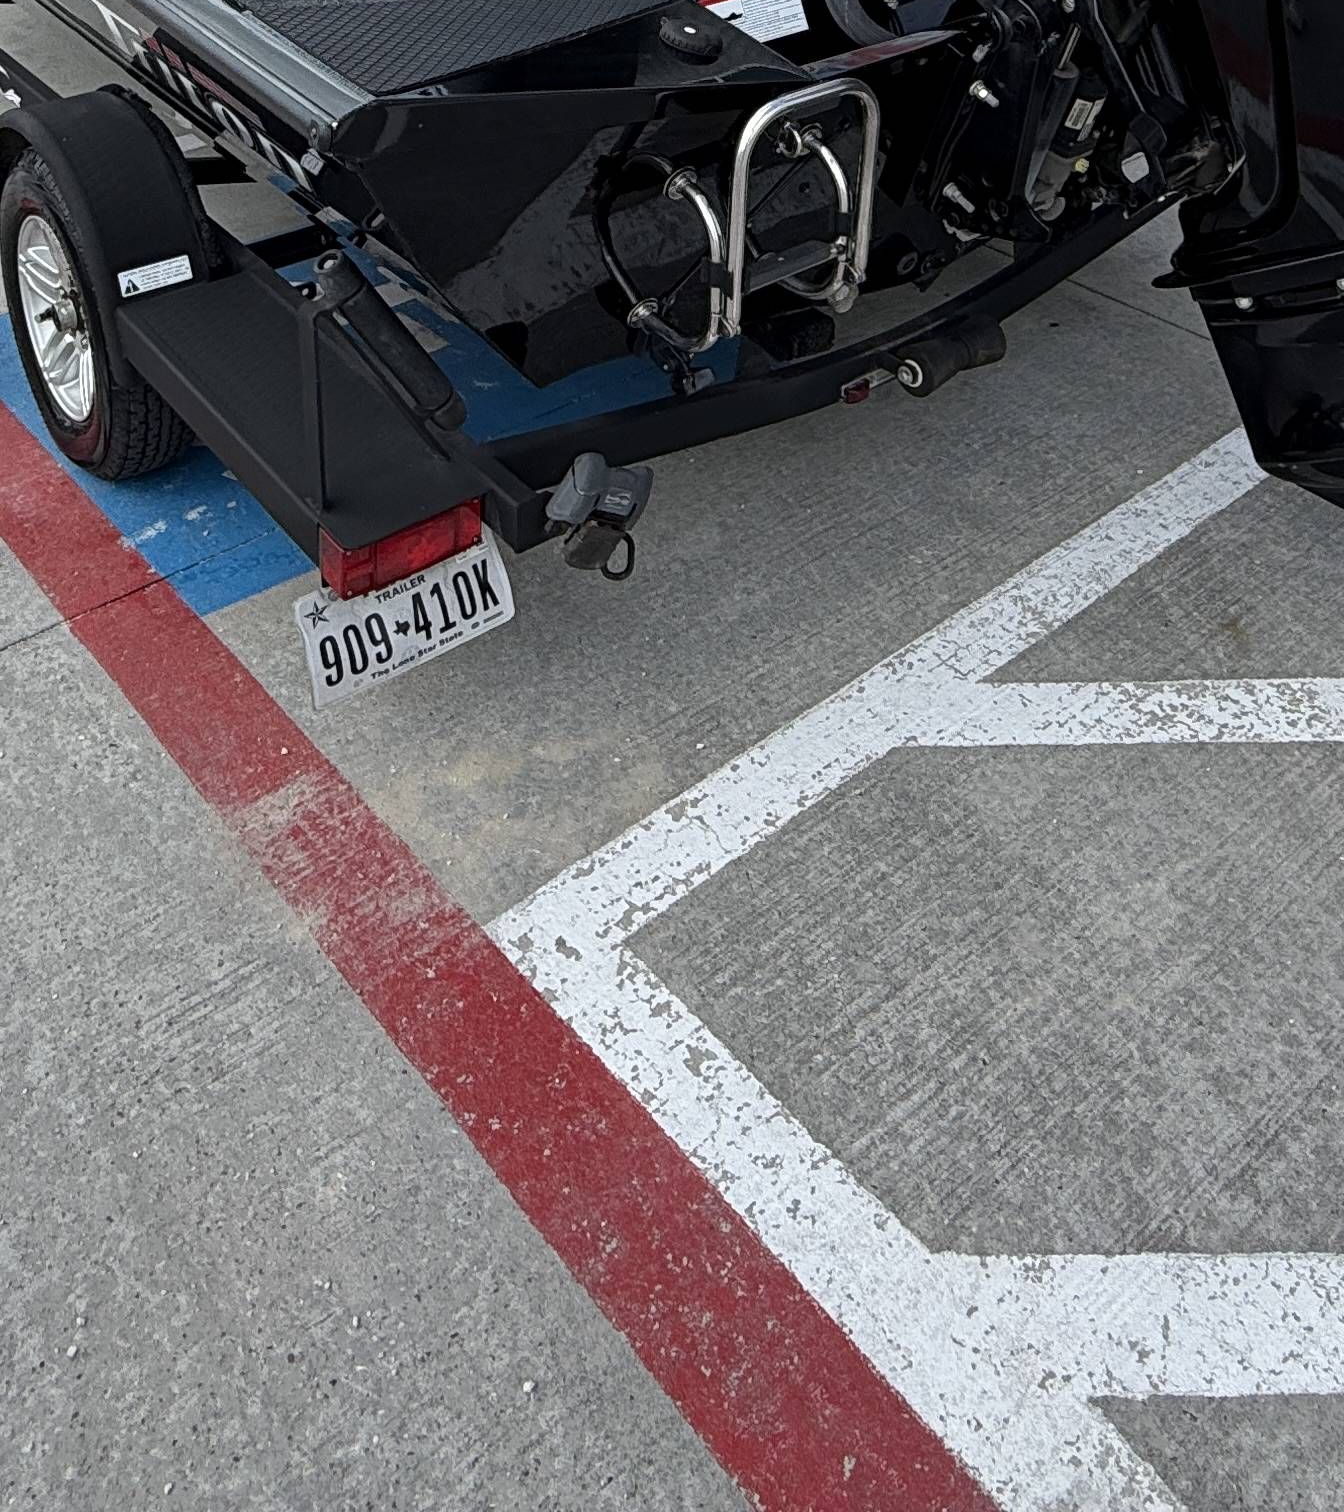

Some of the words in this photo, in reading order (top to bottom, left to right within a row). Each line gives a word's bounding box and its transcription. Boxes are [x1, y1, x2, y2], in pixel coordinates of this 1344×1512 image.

[375, 574, 426, 604] TRAILER
[319, 612, 393, 687] 909
[370, 668, 390, 679] The
[392, 654, 416, 670] Lone
[417, 643, 437, 658] Star
[439, 630, 464, 646] State
